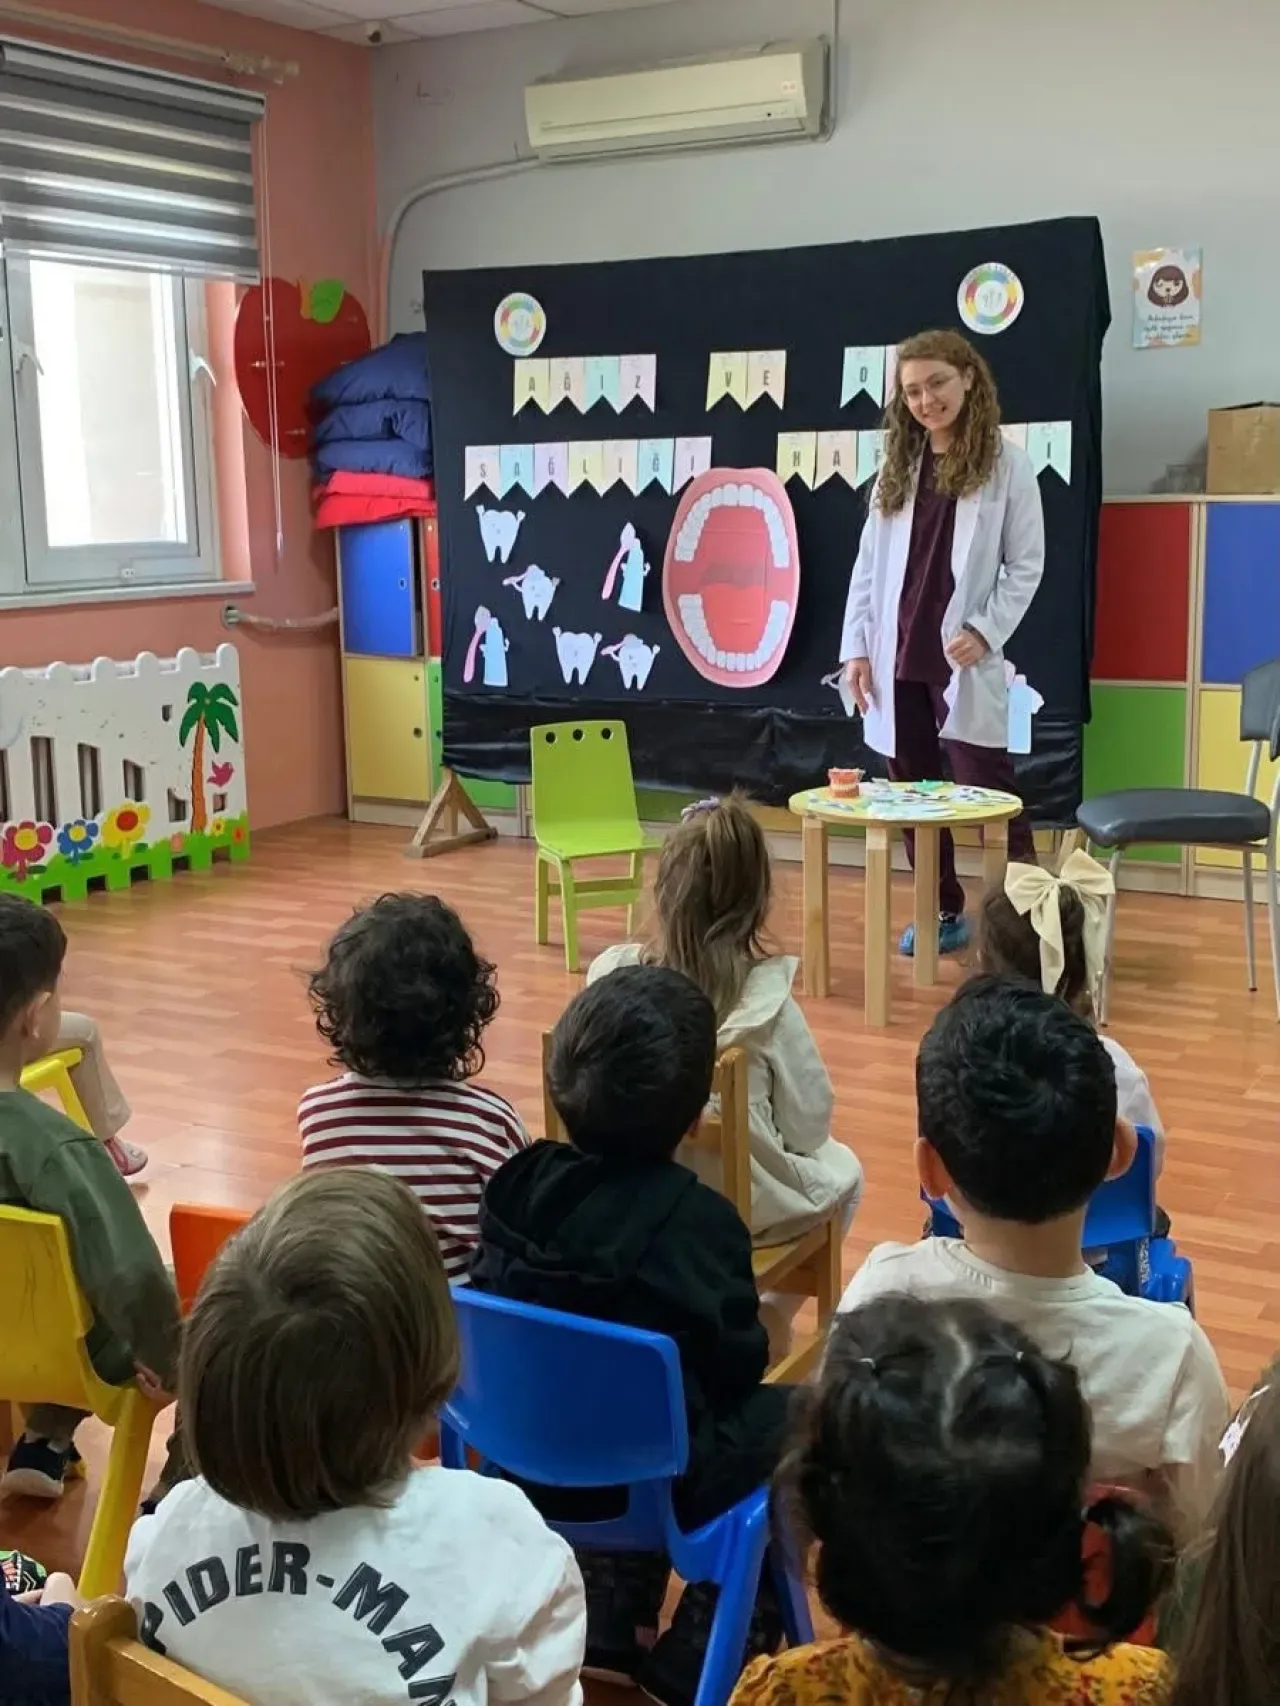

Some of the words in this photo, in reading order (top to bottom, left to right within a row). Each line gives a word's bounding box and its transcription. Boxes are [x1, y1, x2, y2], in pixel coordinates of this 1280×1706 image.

[528, 373, 641, 392] AĞIZ
[724, 370, 771, 387] VE
[479, 452, 694, 477] SAĞLIĞI
